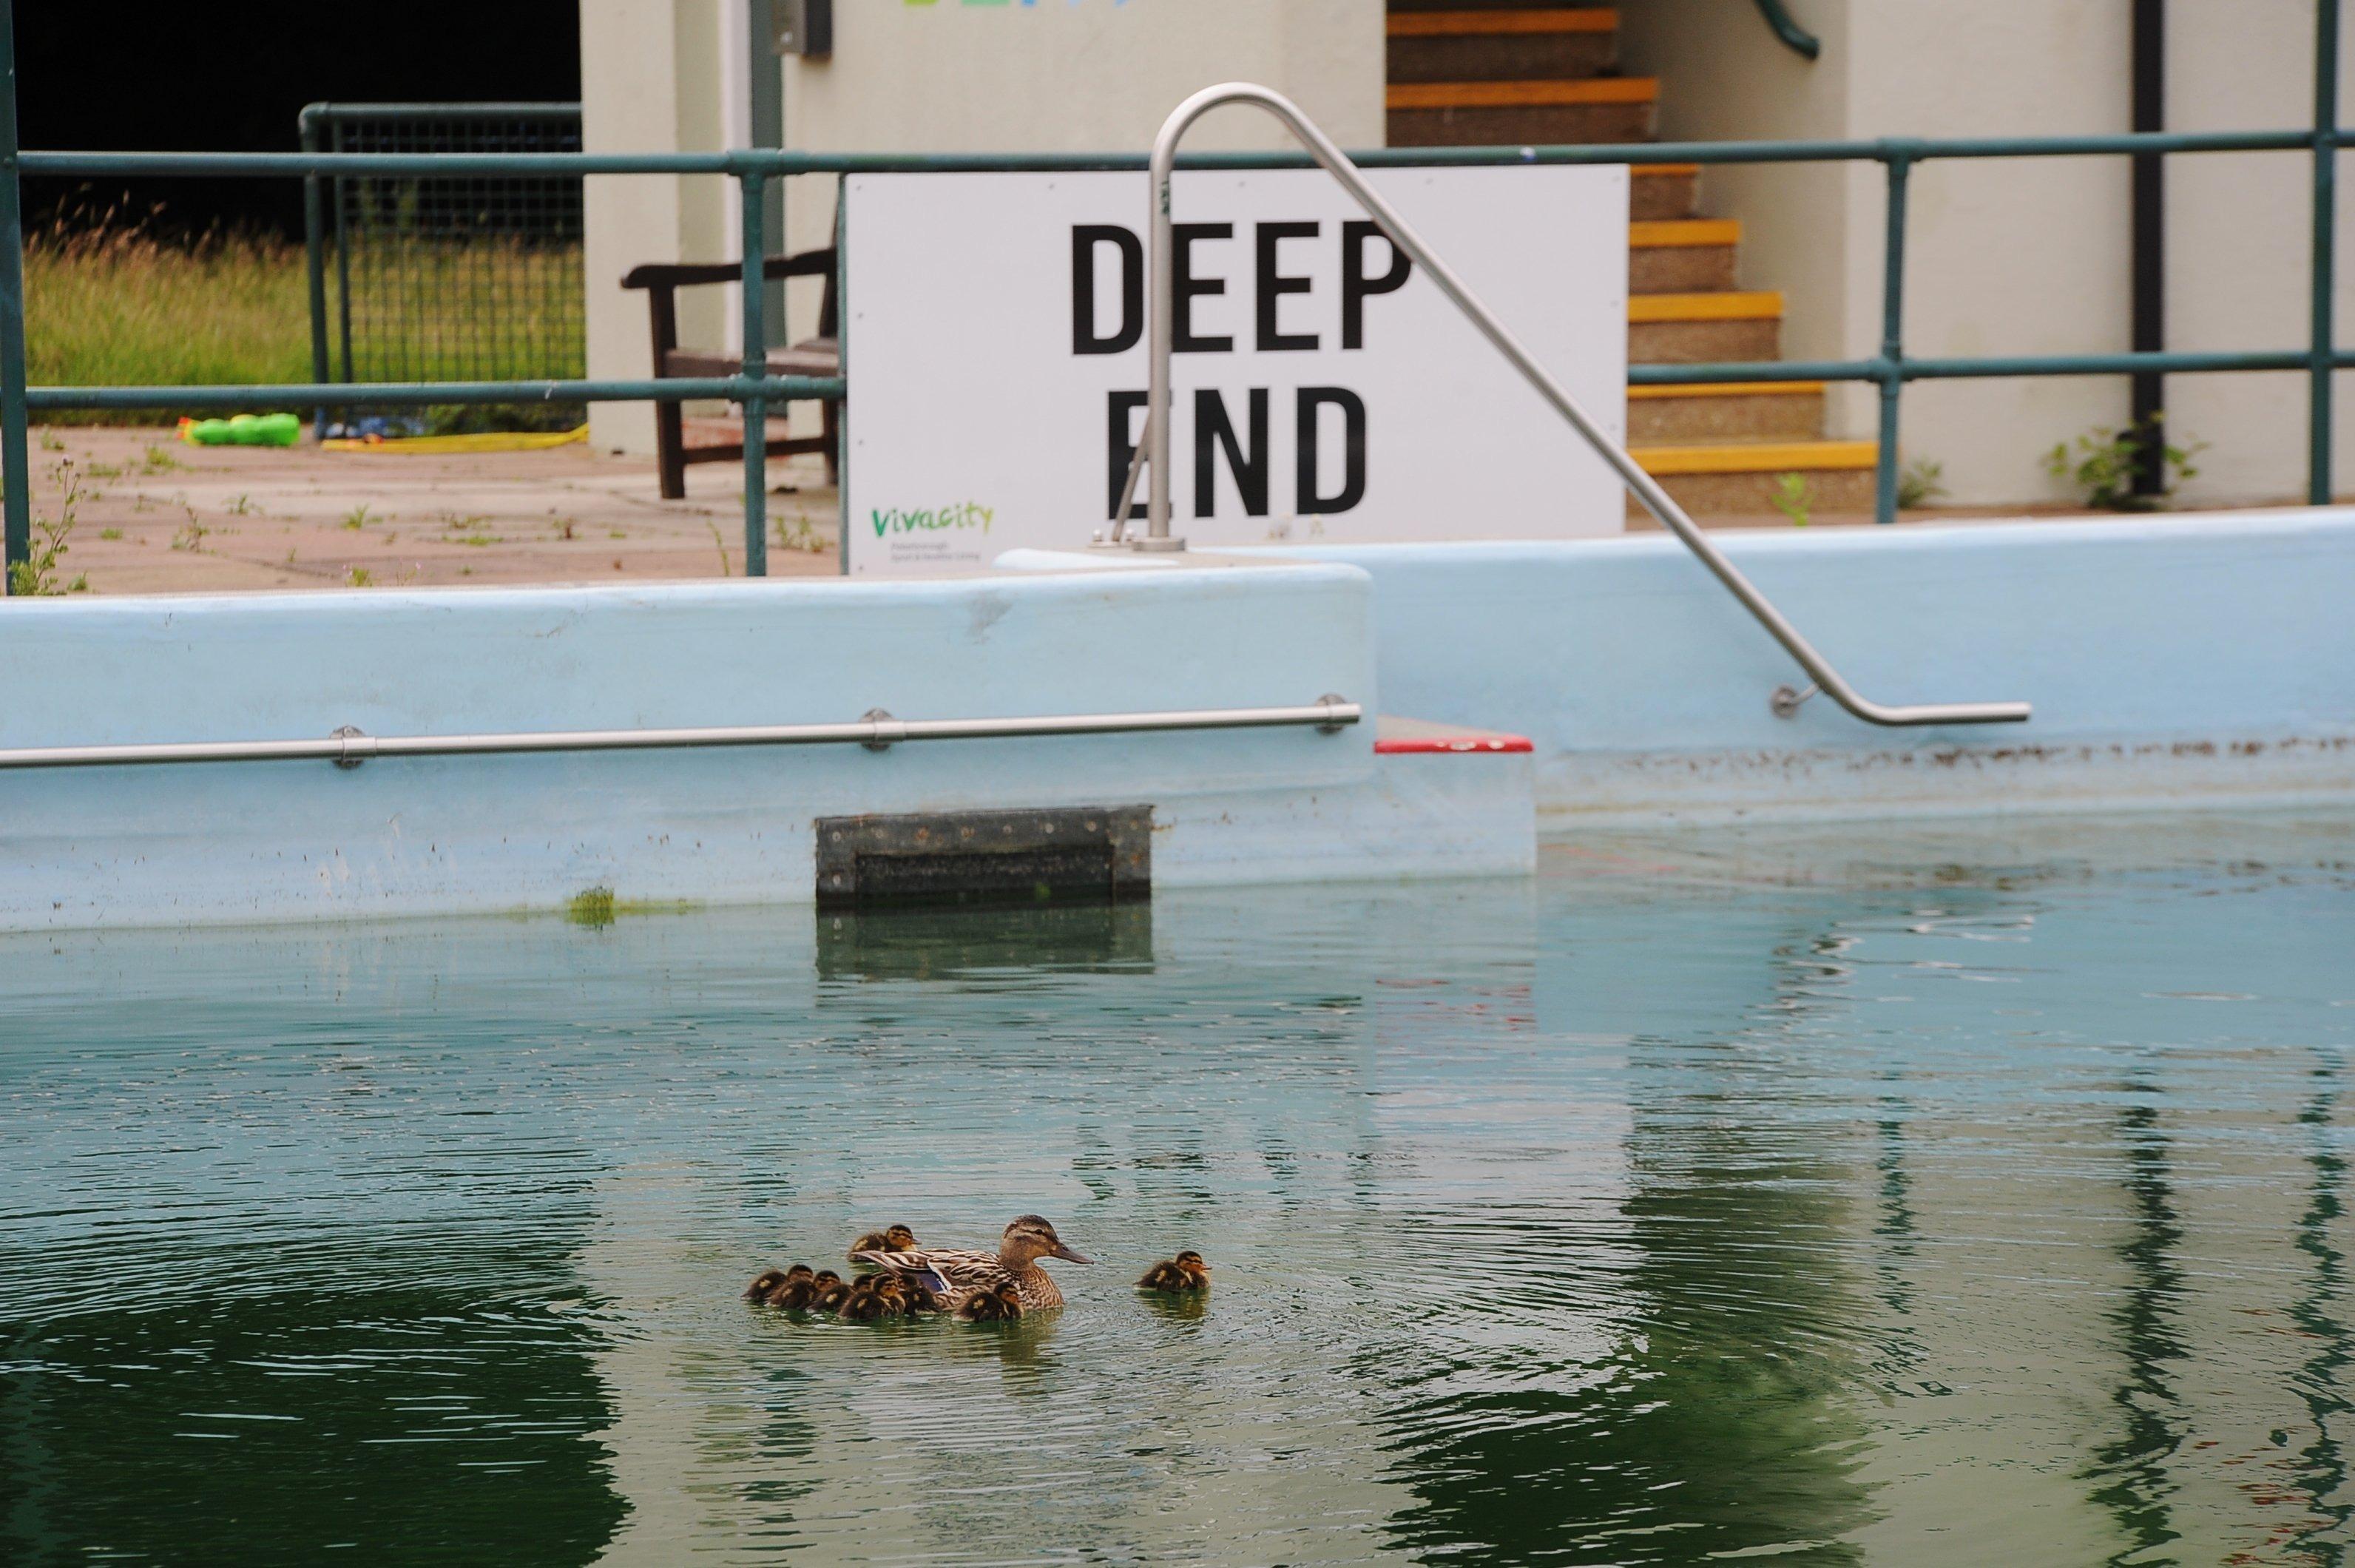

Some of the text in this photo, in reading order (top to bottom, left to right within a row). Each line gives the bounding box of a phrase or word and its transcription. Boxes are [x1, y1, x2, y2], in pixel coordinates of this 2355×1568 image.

[1072, 220, 1412, 354] DEEP
[872, 501, 994, 537] Vivacity
[1108, 386, 1366, 519] END
